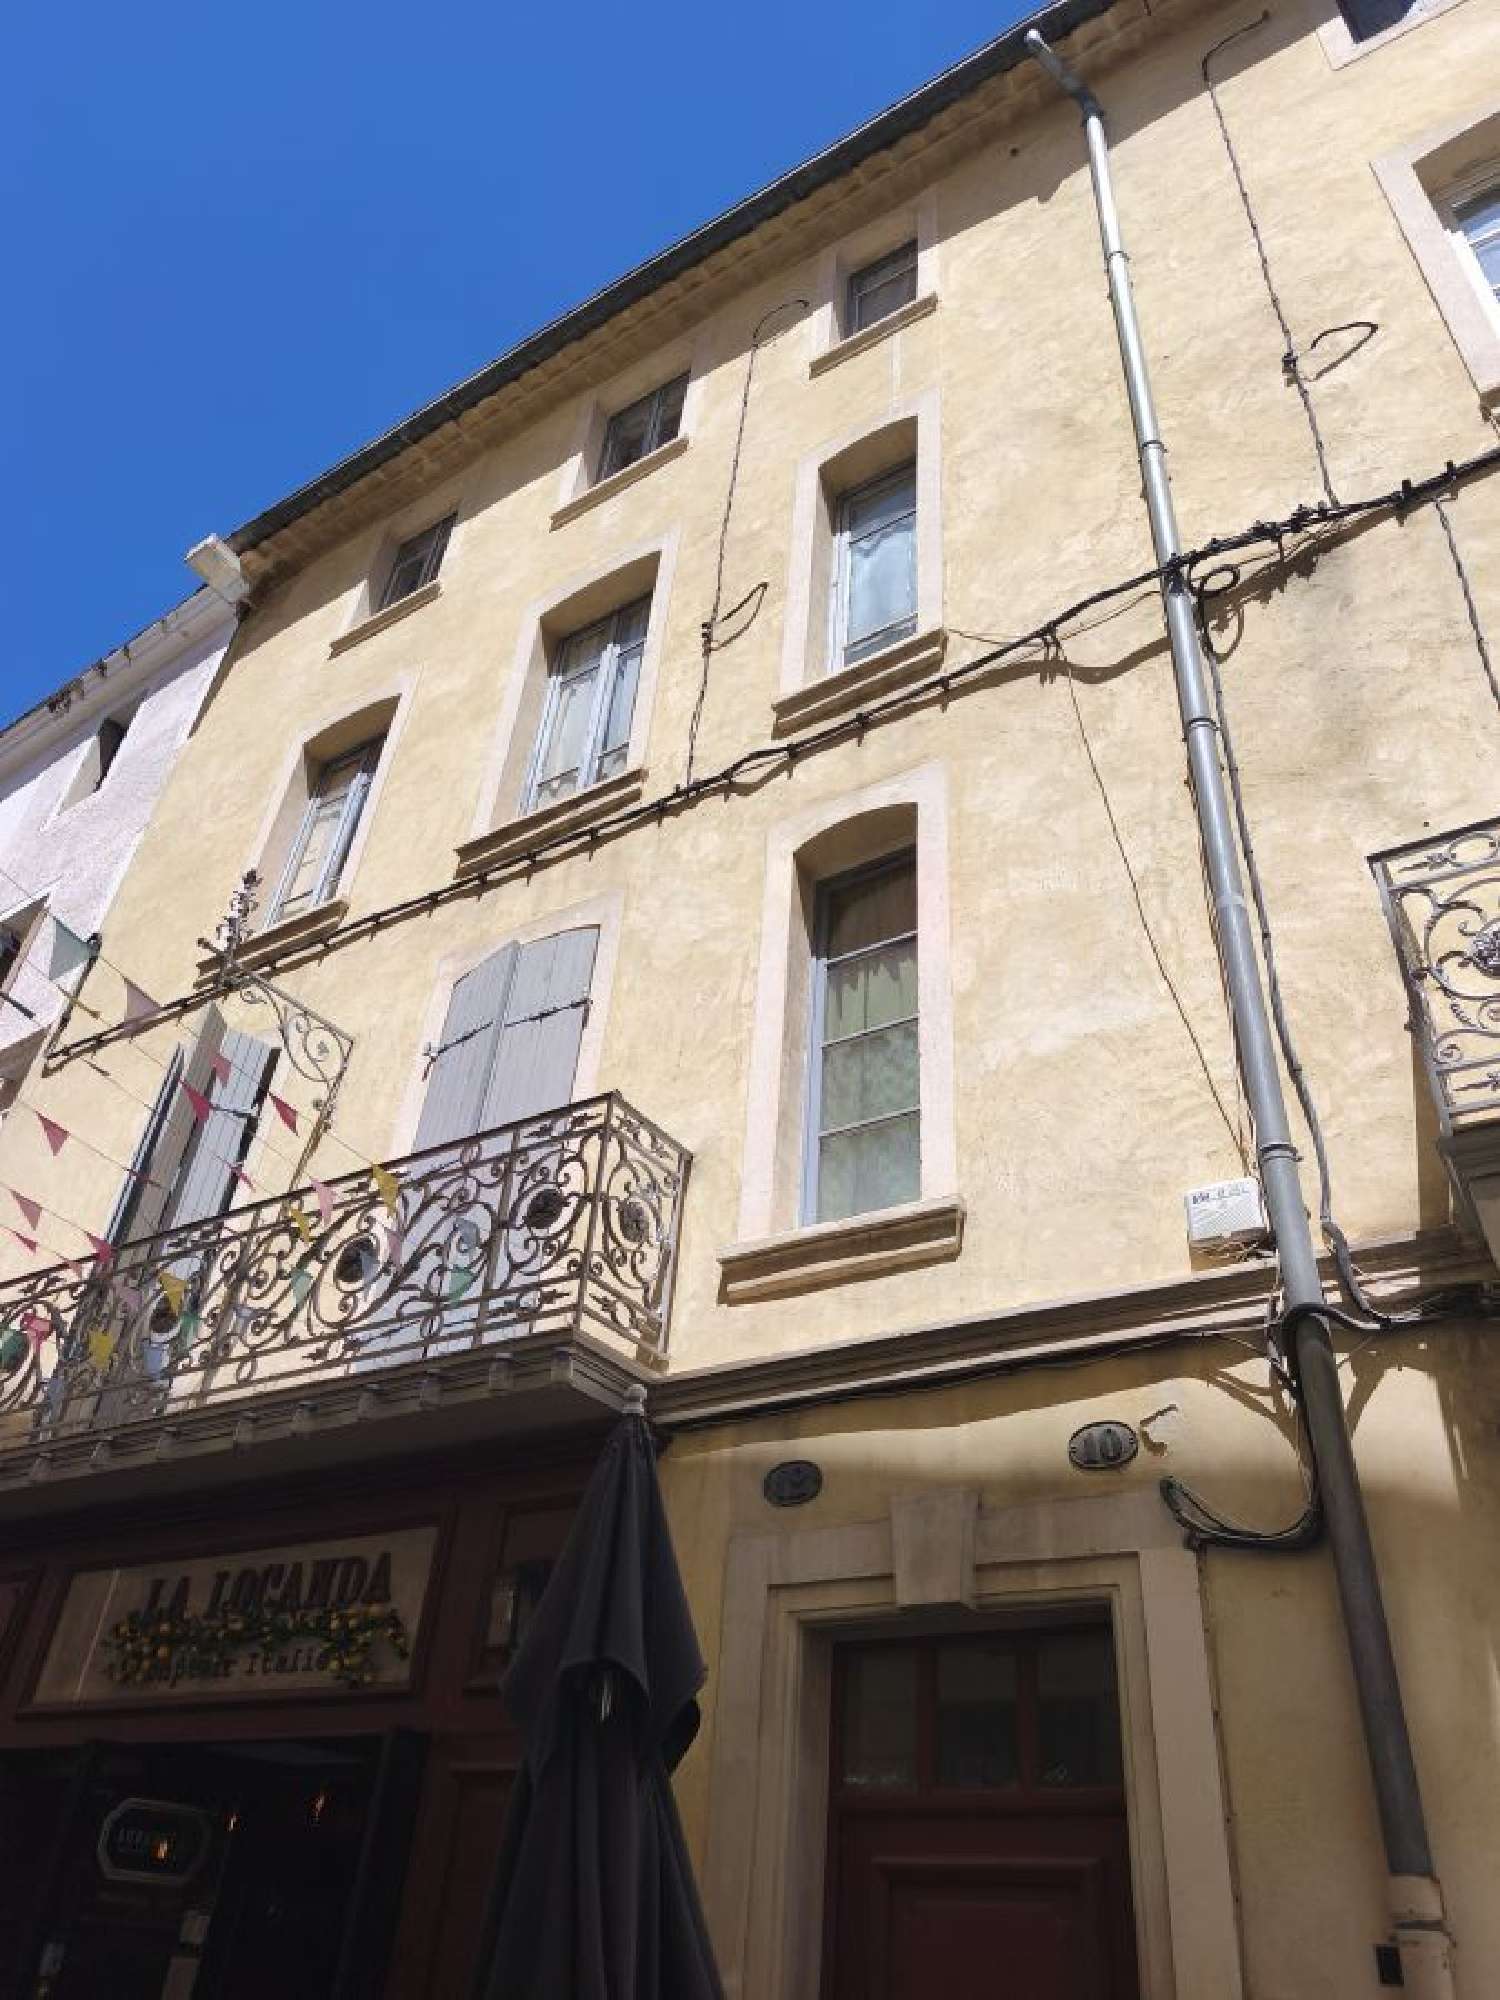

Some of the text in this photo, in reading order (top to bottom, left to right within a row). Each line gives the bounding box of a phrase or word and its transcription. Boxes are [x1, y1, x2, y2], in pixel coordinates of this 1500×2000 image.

[1083, 1428, 1122, 1463] 10
[143, 1552, 391, 1622] LA LOCANDA
